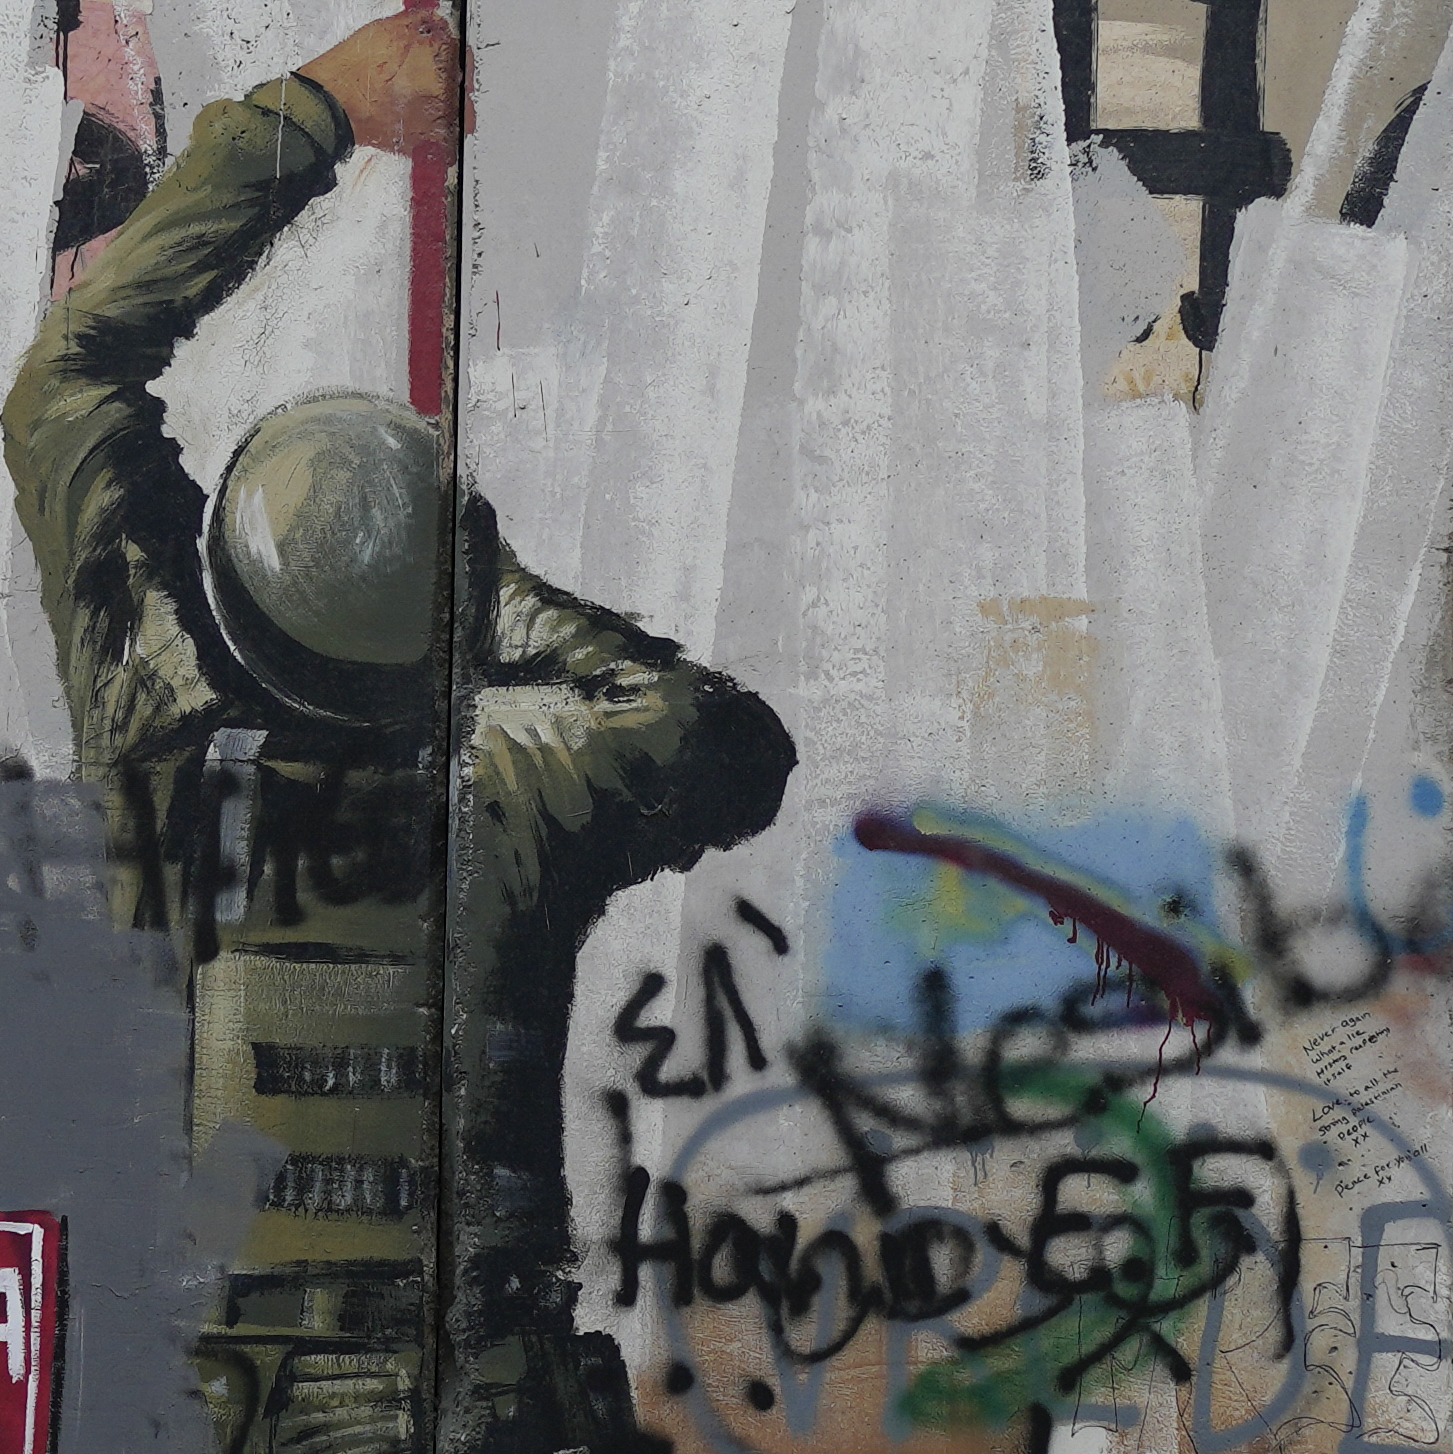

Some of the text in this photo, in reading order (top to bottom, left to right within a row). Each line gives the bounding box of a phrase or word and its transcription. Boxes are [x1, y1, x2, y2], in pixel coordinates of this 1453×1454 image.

[1302, 1011, 1372, 1057] Never again
[1348, 1088, 1361, 1098] to
[1363, 1077, 1380, 1092] all
